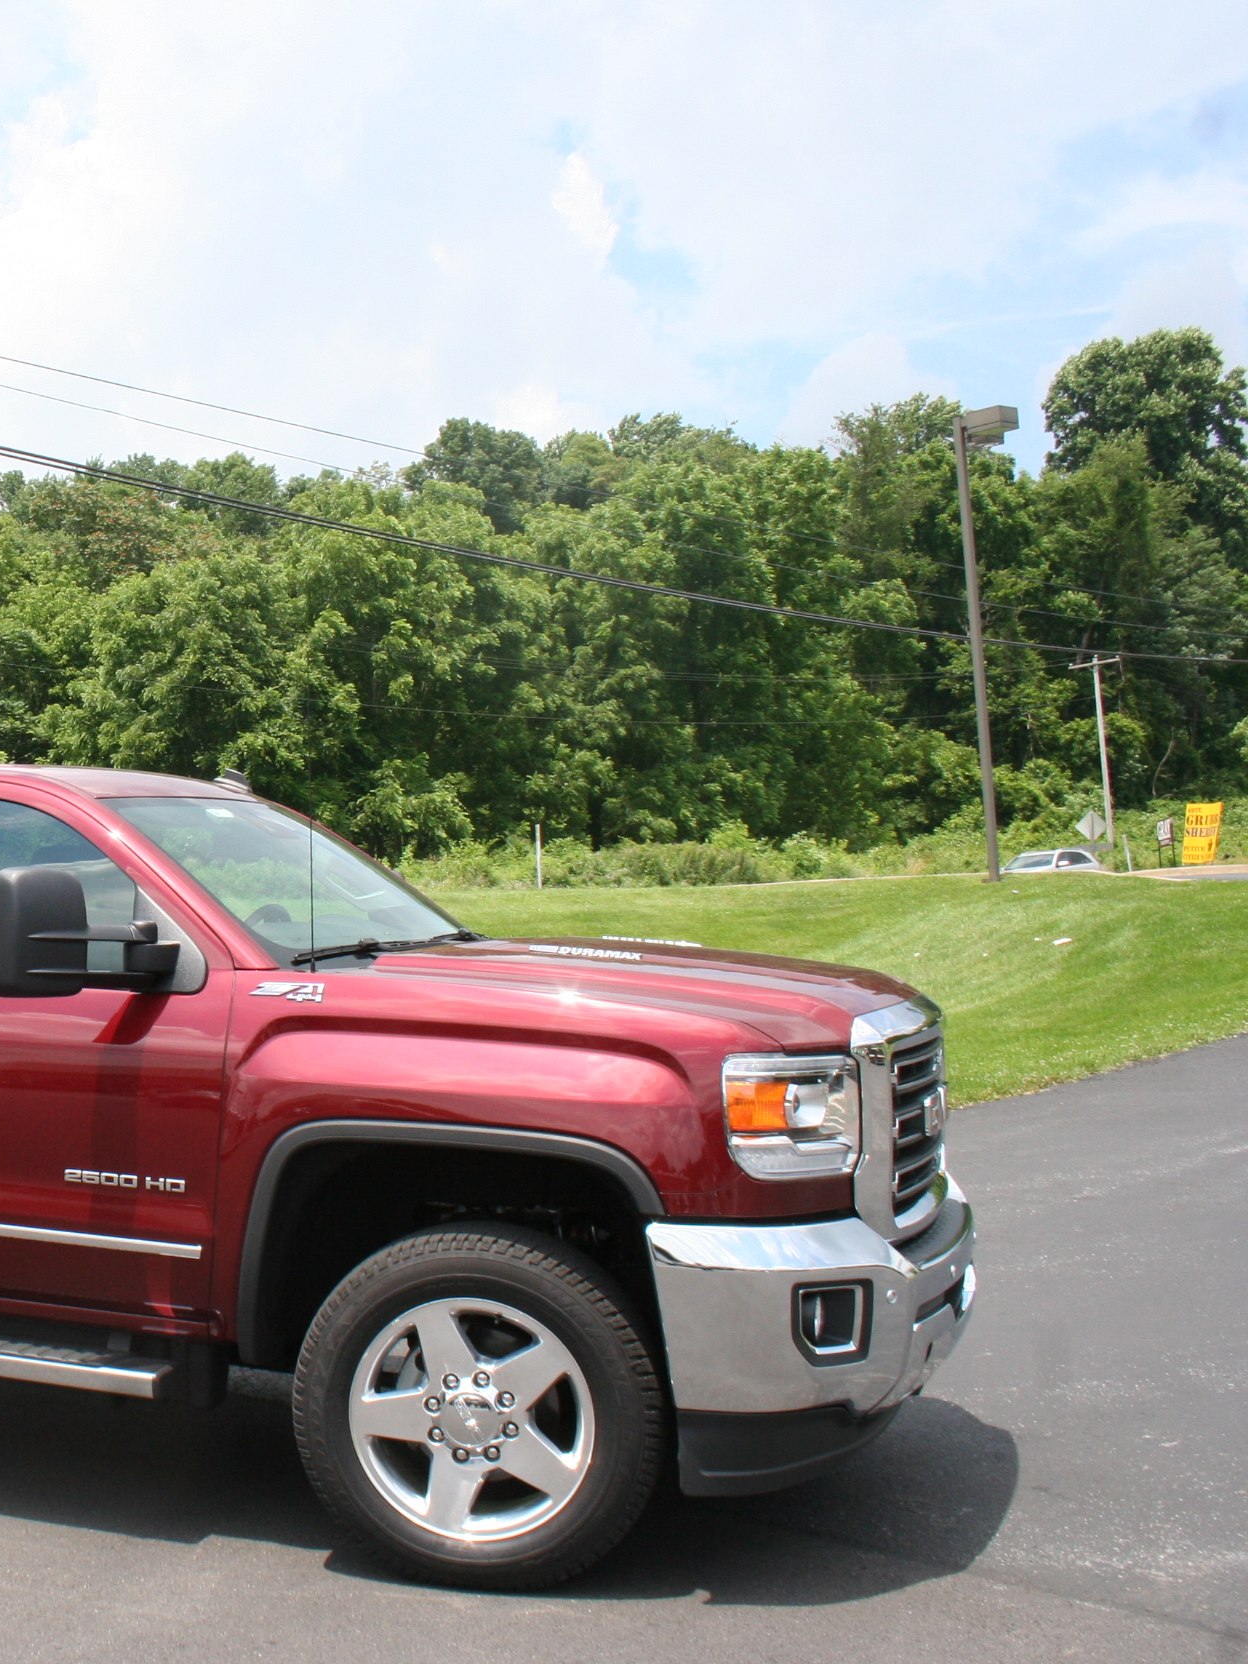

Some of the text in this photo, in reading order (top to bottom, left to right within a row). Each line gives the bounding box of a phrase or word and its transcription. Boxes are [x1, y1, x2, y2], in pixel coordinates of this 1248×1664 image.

[557, 946, 643, 961] DURAMAX
[64, 1168, 186, 1193] 2500 HD
